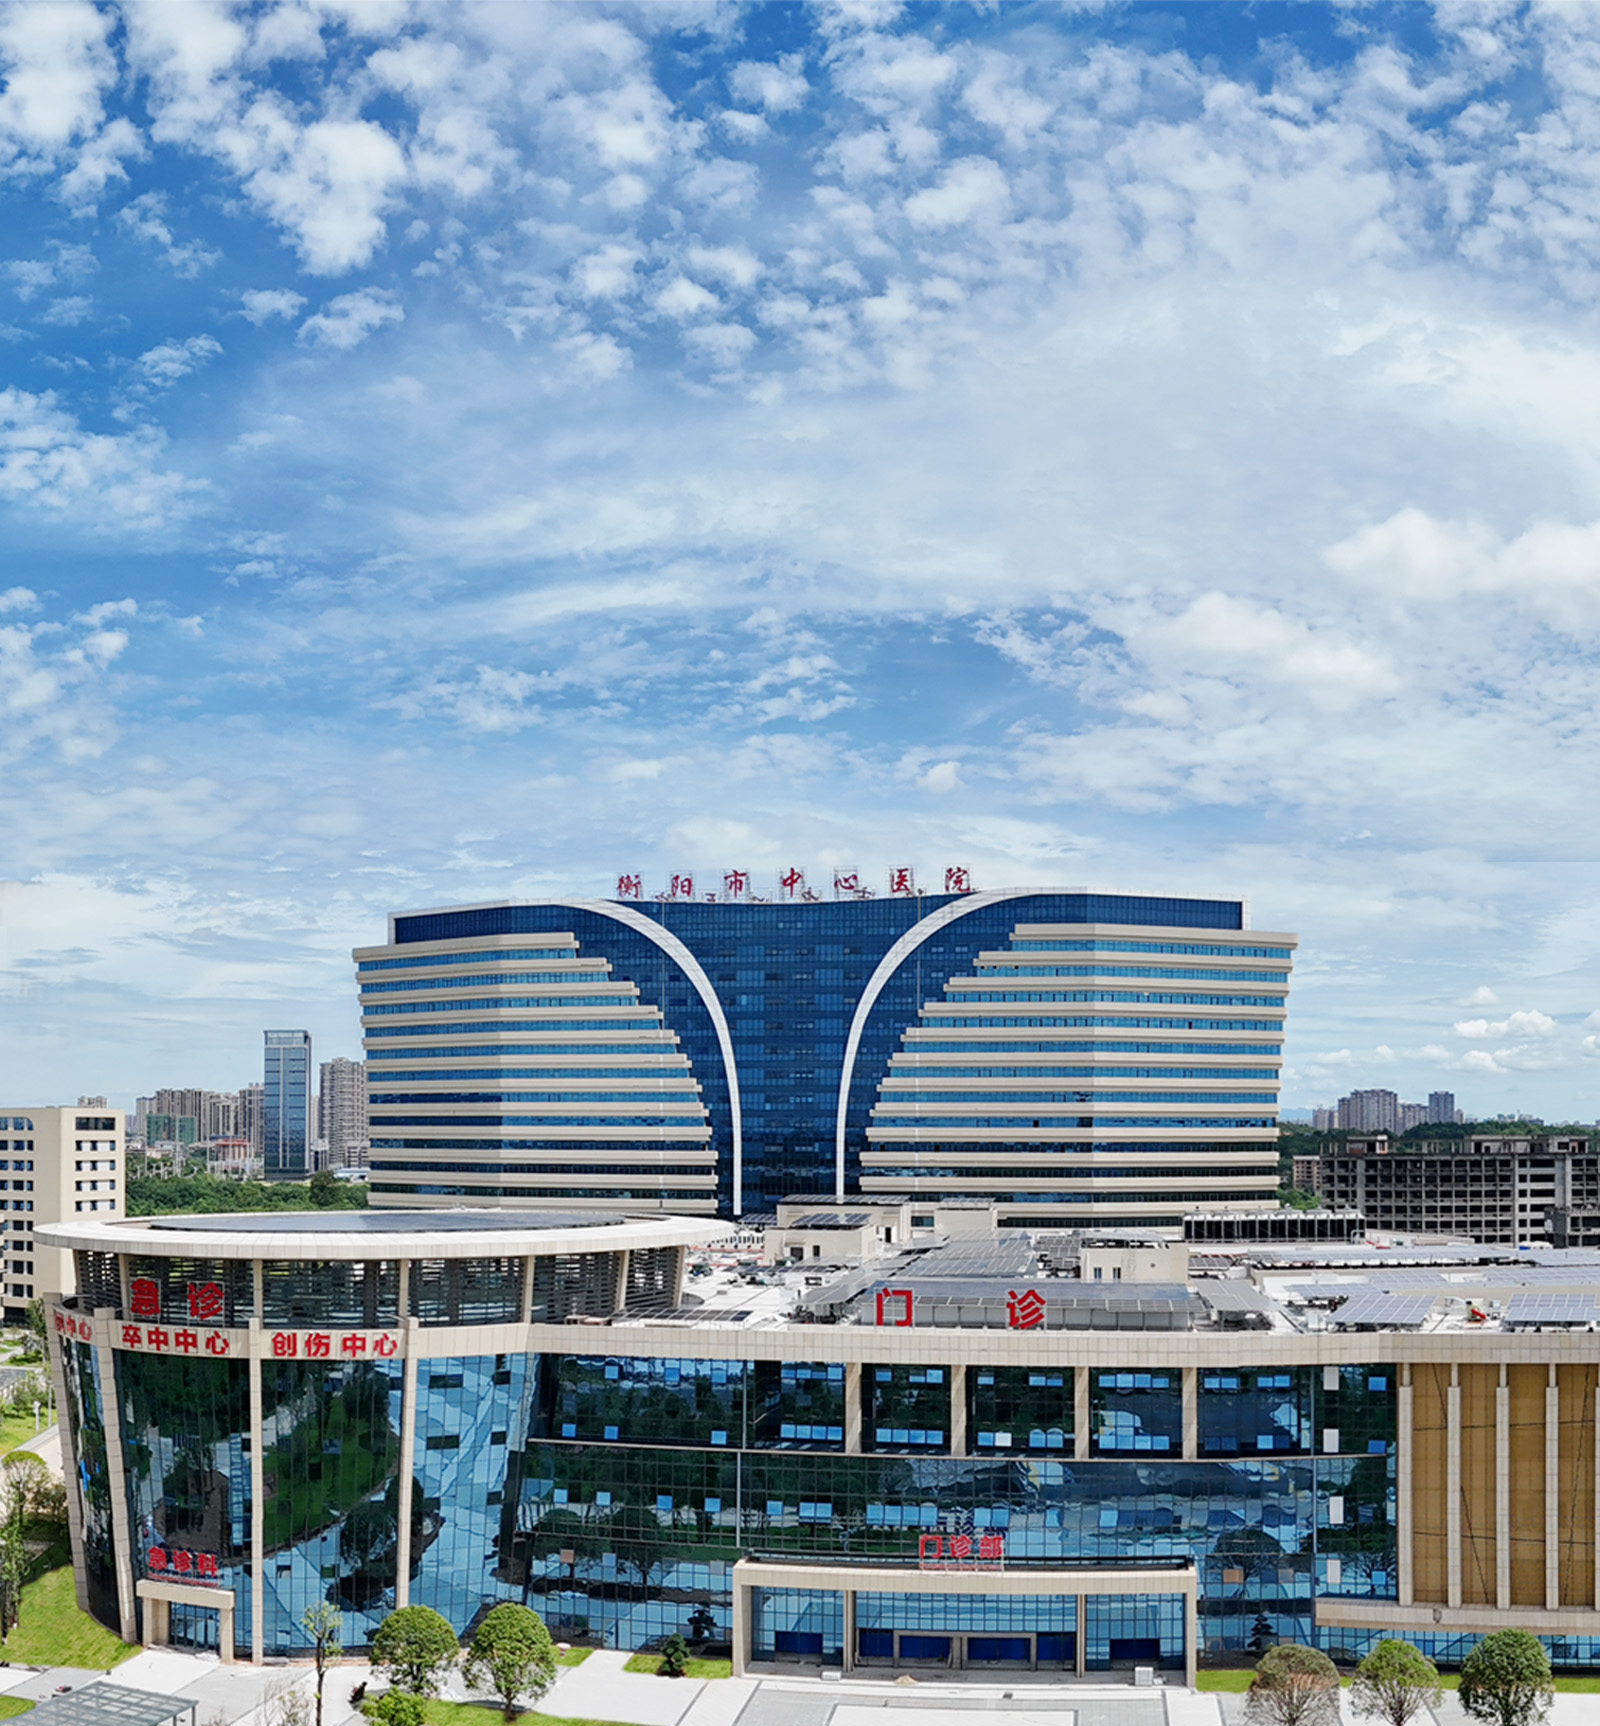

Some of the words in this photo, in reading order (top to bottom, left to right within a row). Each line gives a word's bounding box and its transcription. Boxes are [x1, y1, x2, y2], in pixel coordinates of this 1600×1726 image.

[617, 867, 970, 899] 衡阳市中心医院
[130, 1278, 225, 1319] 急诊
[876, 1287, 1046, 1330] 门诊
[122, 1324, 230, 1356] 卒中中心
[271, 1332, 398, 1358] 创伤中心
[148, 1546, 218, 1577] 急诊科
[919, 1534, 1003, 1559] 门诊部
